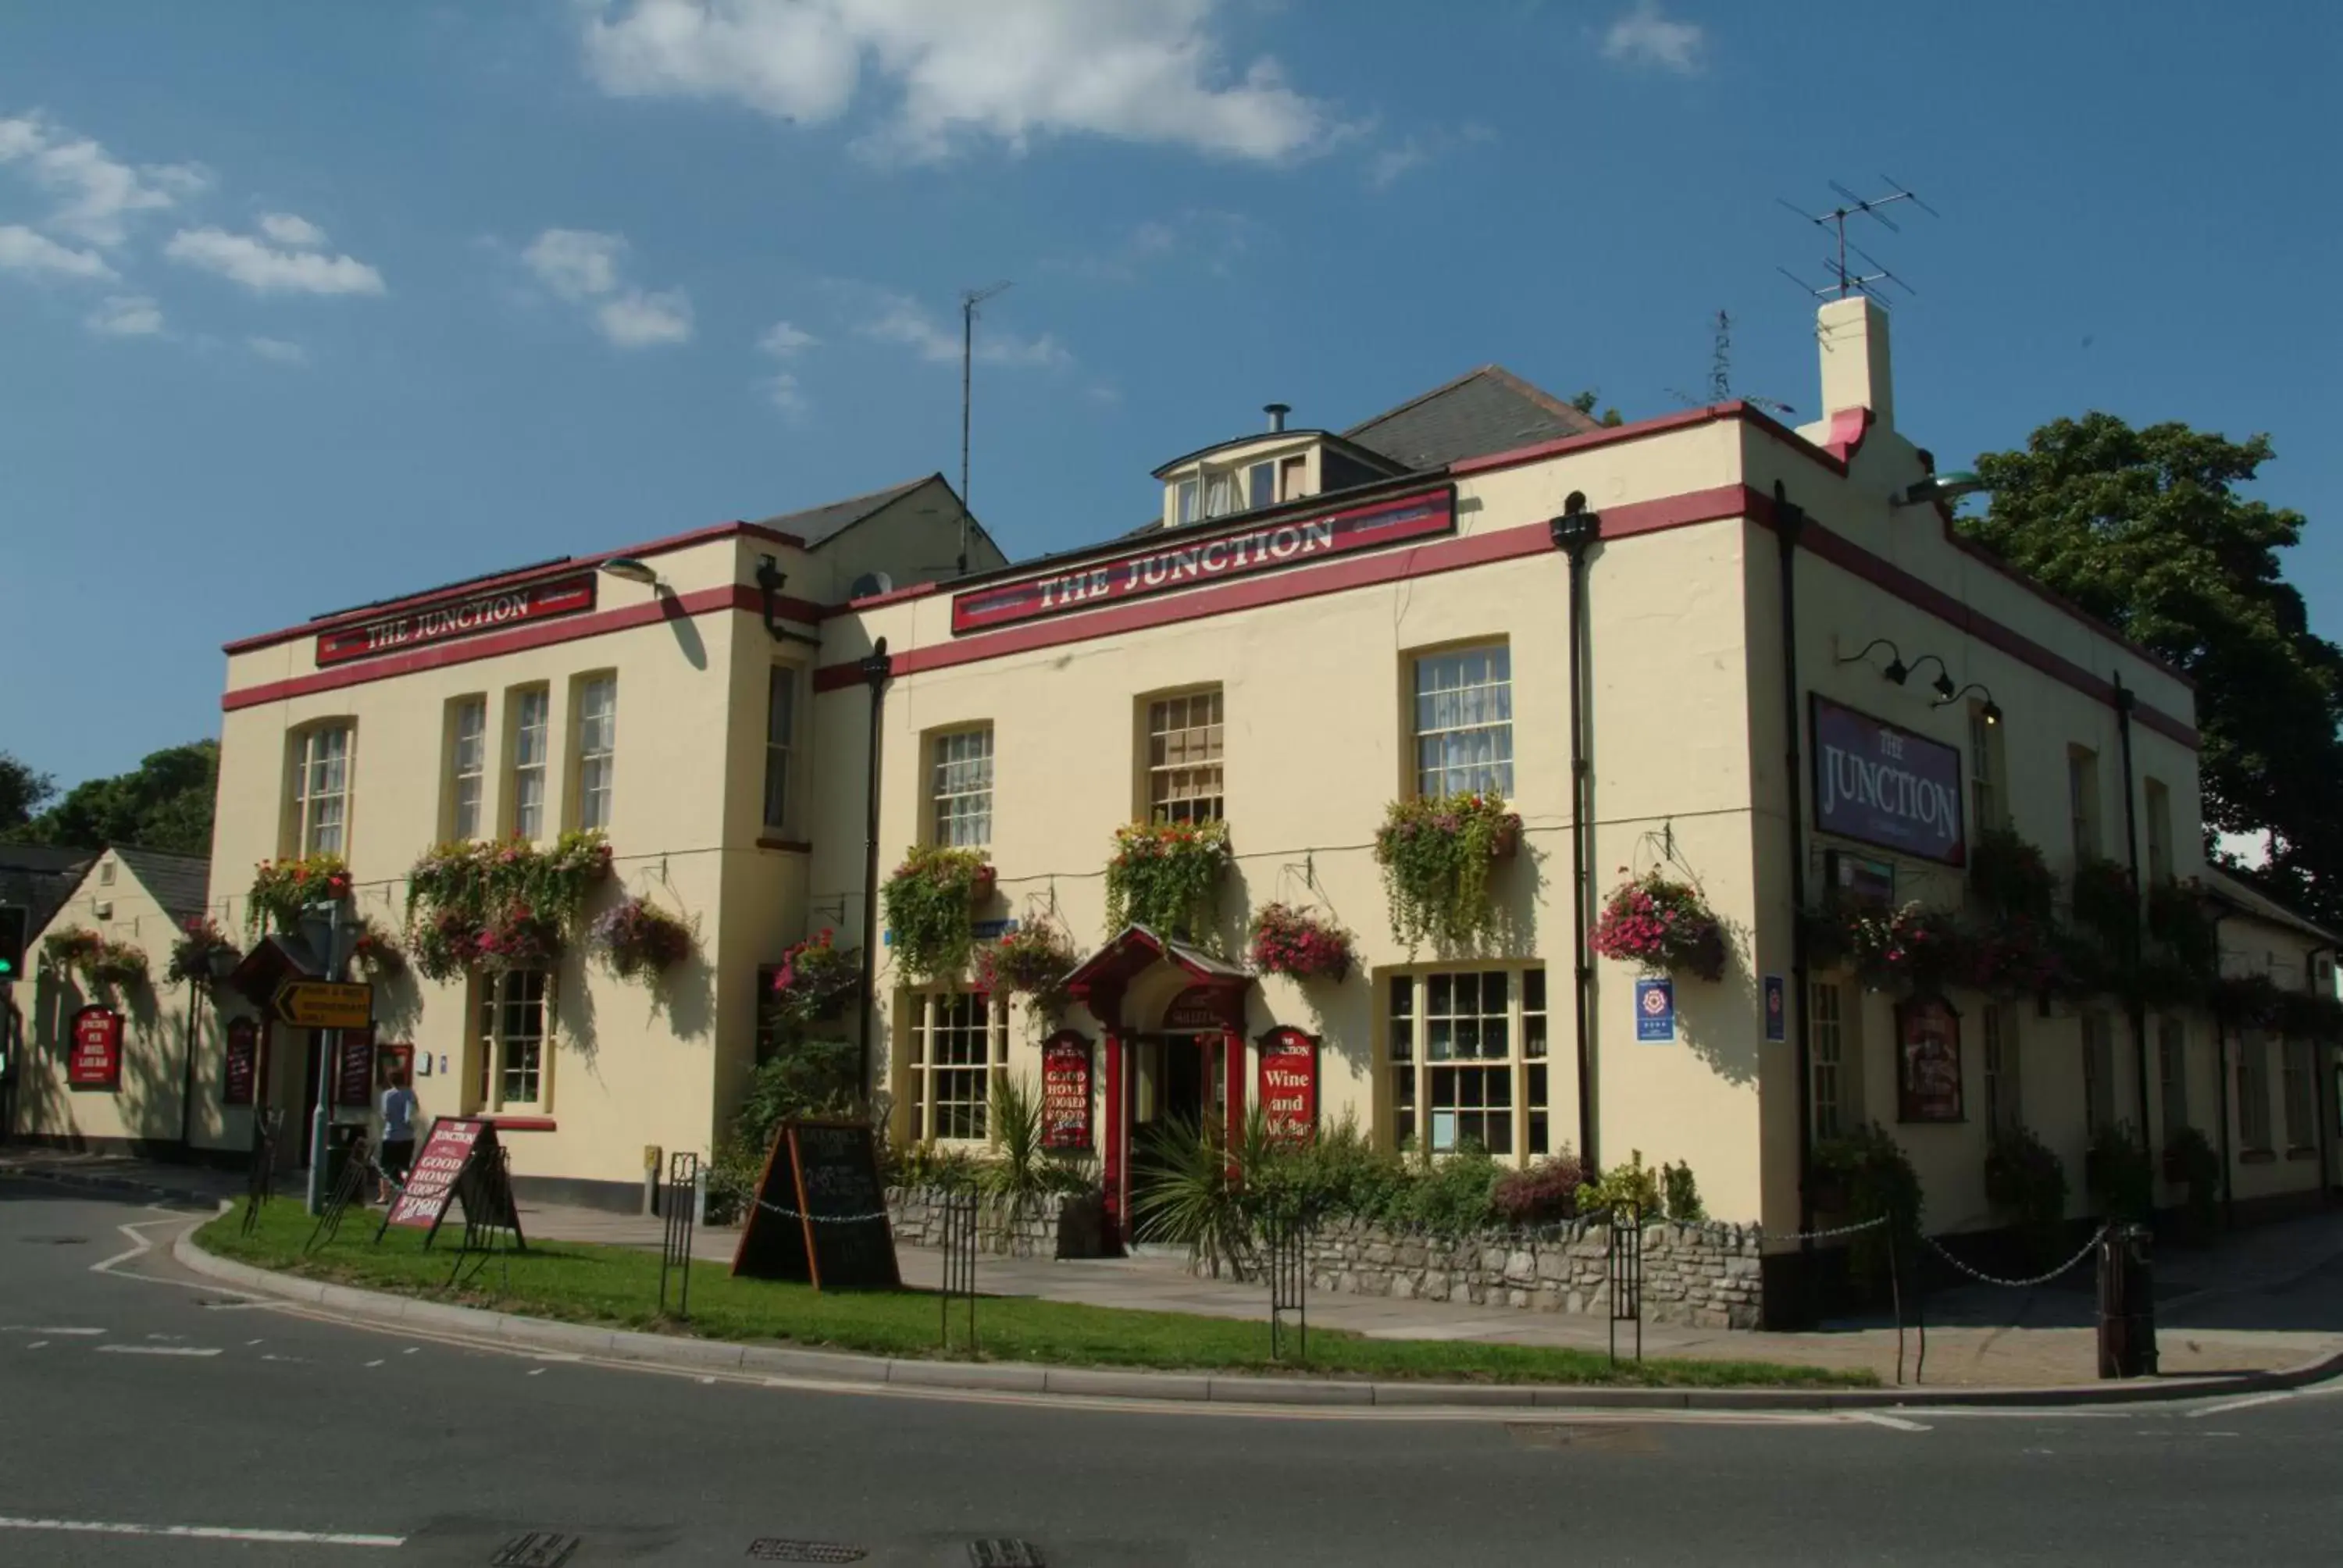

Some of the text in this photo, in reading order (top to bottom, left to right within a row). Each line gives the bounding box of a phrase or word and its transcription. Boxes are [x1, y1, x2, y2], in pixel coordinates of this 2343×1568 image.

[1037, 569, 1110, 609] THE
[1124, 519, 1337, 592] JUNCTION
[366, 619, 410, 650] THE
[415, 592, 530, 639] JUNCTION
[1878, 729, 1904, 761] THE
[1823, 744, 1956, 843] JUNCTION
[1047, 1071, 1087, 1082] GOOD
[1264, 1069, 1310, 1087] Wine
[1047, 1083, 1086, 1096] HOME
[1272, 1094, 1303, 1111] and
[430, 1130, 477, 1144] JUNCTION
[420, 1156, 463, 1169] GOOD
[414, 1170, 457, 1183] HOME
